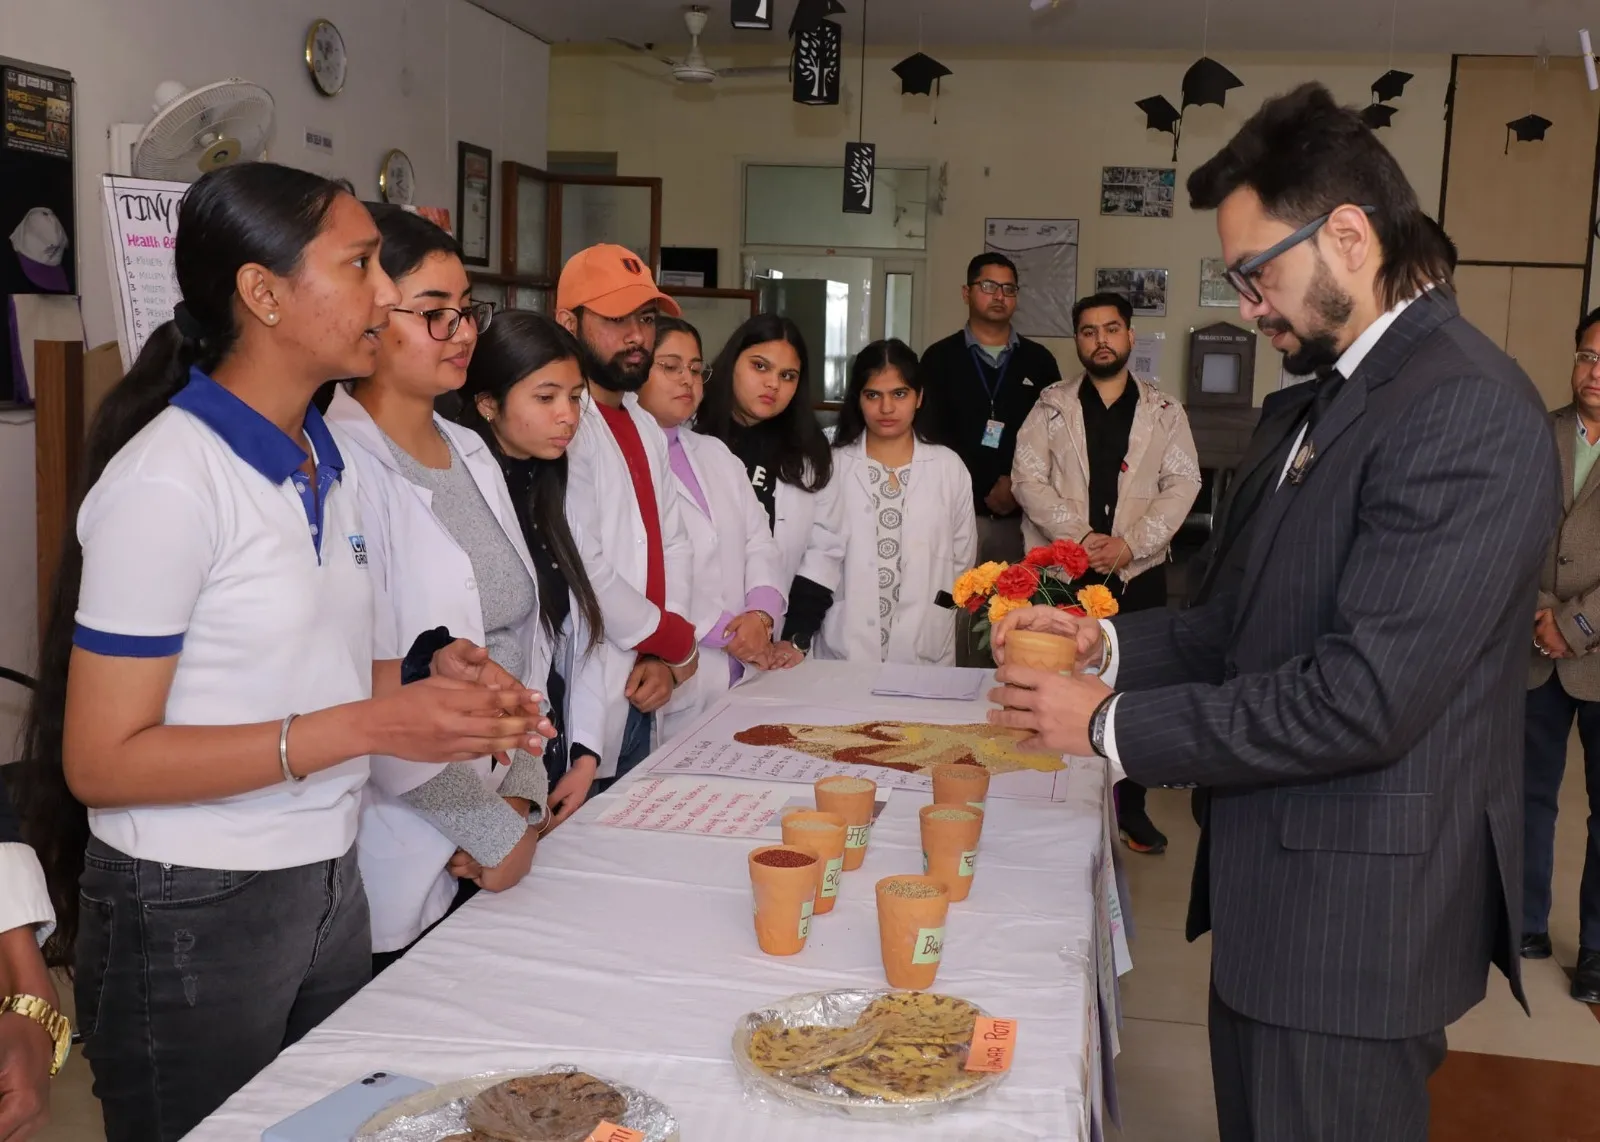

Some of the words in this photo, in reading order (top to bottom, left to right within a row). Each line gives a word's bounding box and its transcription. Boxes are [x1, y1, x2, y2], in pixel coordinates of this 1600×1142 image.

[119, 193, 173, 233] TINY
[126, 233, 160, 249] Health
[983, 1020, 1011, 1041] ROTI
